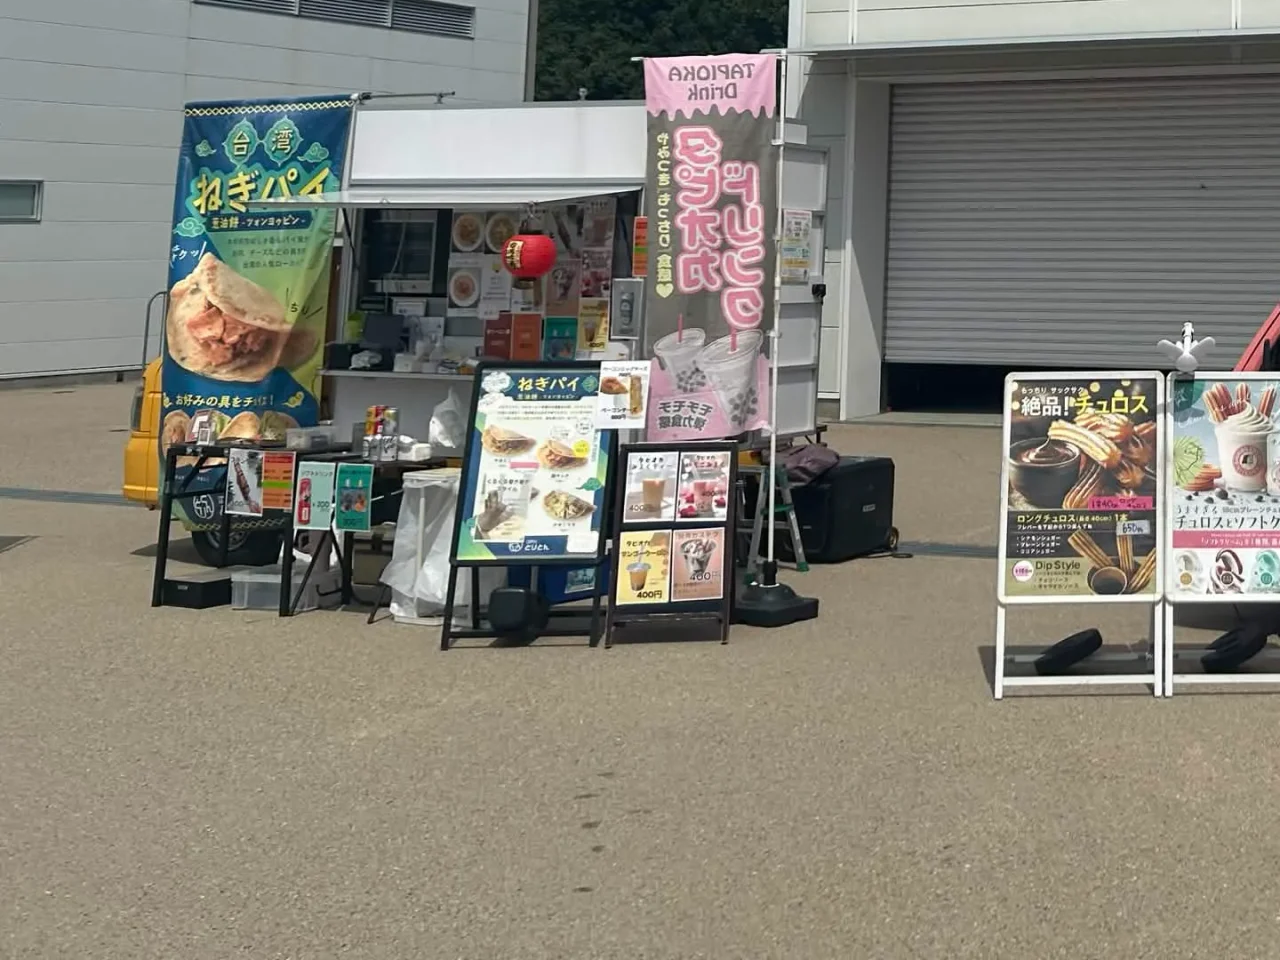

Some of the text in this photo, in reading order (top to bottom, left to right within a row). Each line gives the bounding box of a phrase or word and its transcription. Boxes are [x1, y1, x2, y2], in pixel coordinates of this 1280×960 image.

[233, 127, 294, 156] 台湾
[193, 167, 330, 214] ねぎパイ
[518, 376, 580, 392] ねぎパイ
[1035, 559, 1081, 571] Dip Style
[637, 590, 662, 599] 400円
